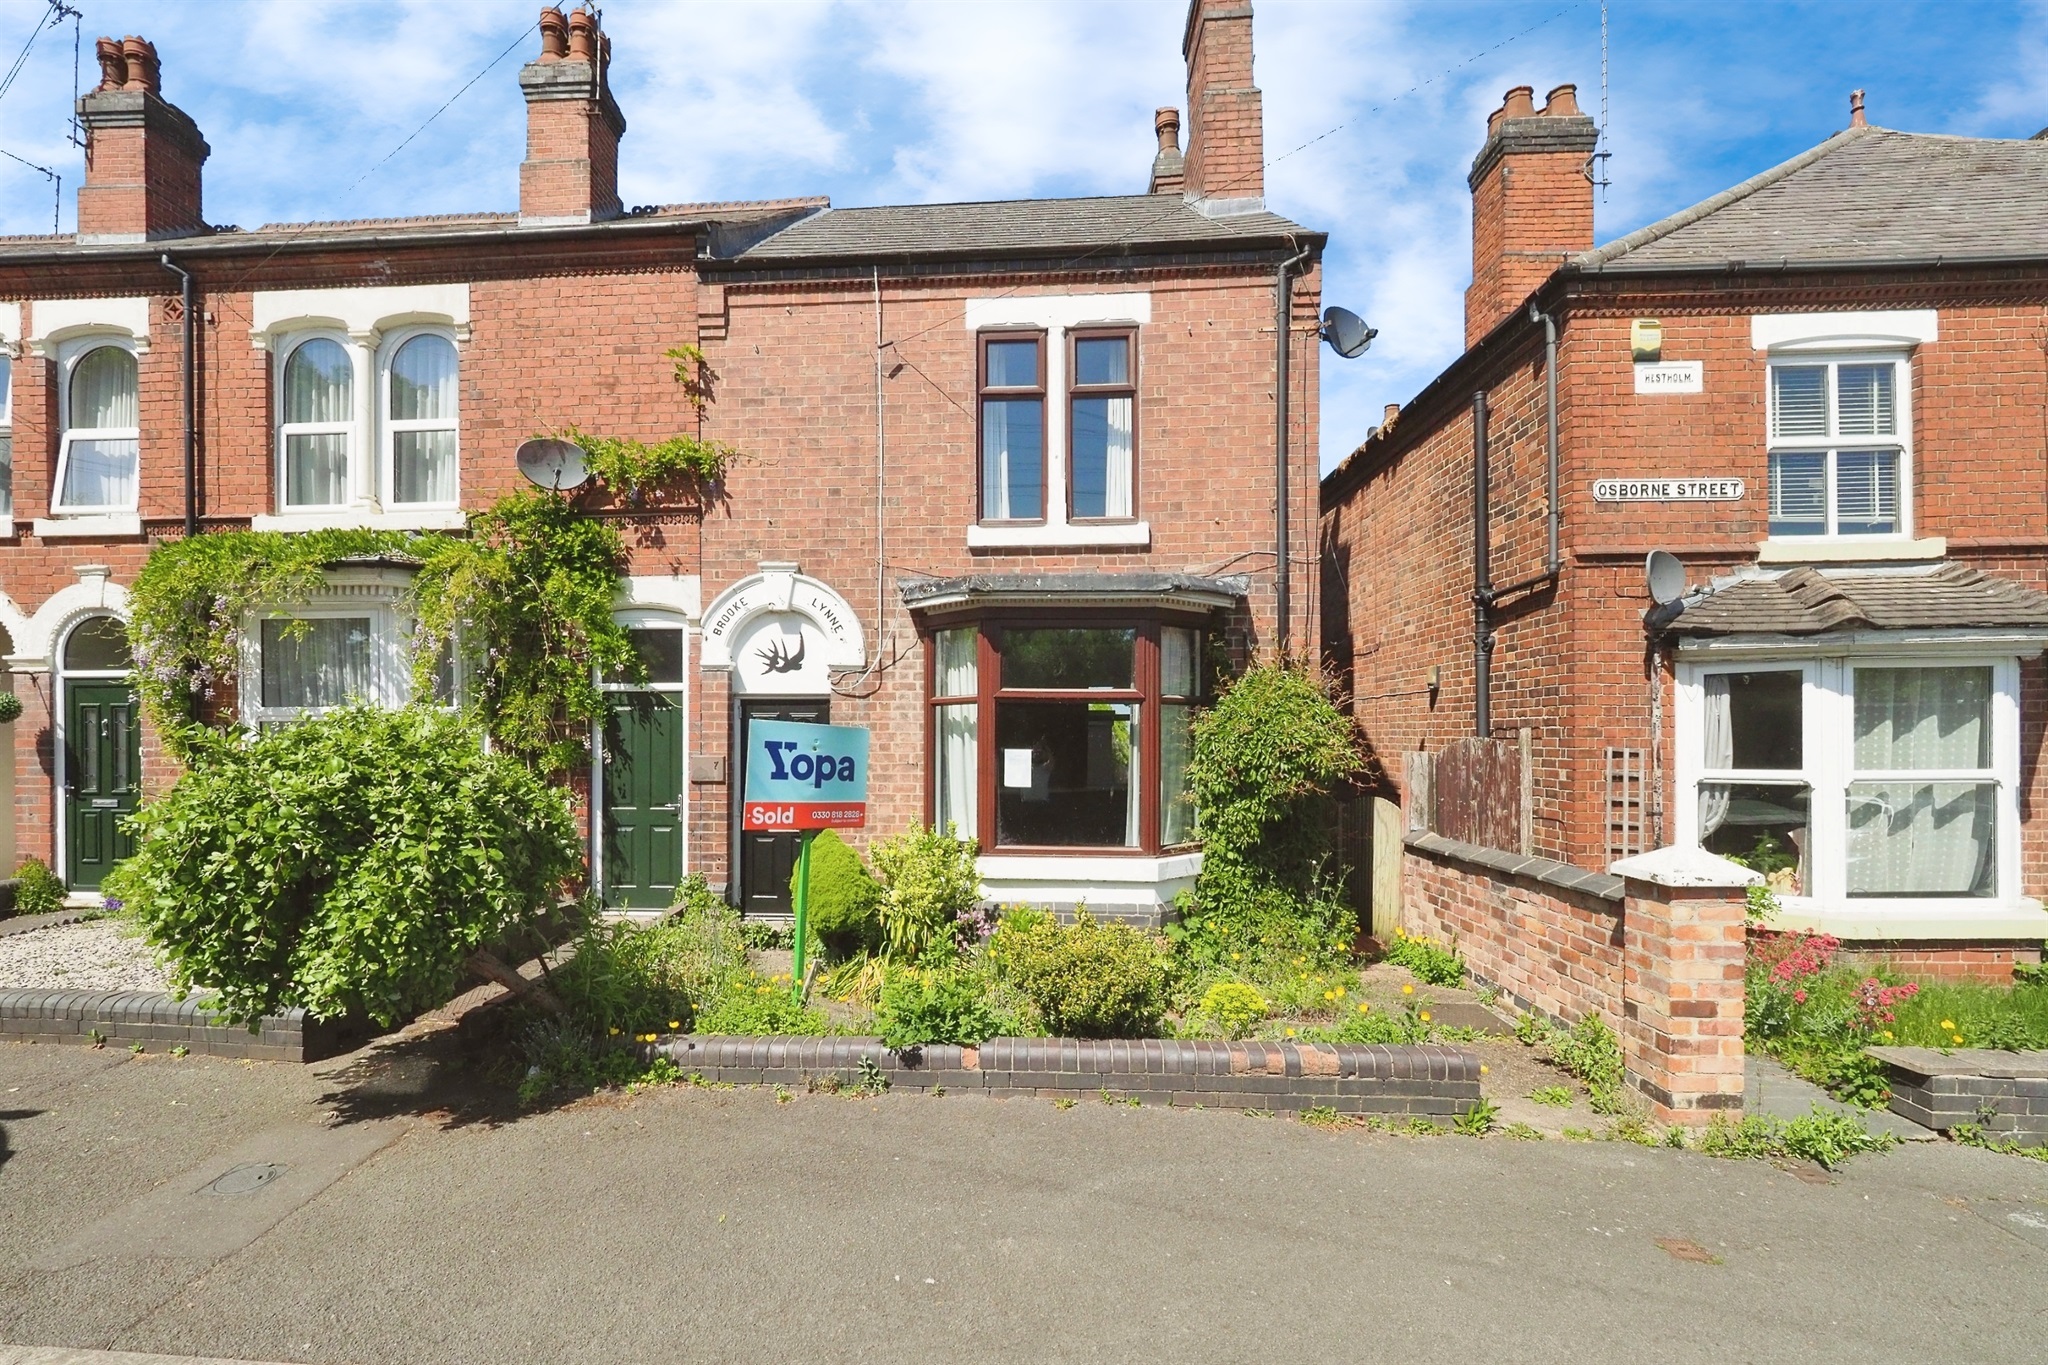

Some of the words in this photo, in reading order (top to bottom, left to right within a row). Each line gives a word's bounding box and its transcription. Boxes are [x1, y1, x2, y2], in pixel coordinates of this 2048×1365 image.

[1598, 484, 1670, 496] OSBORNE
[1677, 482, 1740, 496] STREET
[713, 597, 748, 636] BROOKE
[811, 598, 844, 635] LYNNE
[713, 761, 719, 770] 7
[764, 741, 855, 788] Yopa
[751, 806, 794, 825] Sold
[812, 811, 830, 819] 0330
